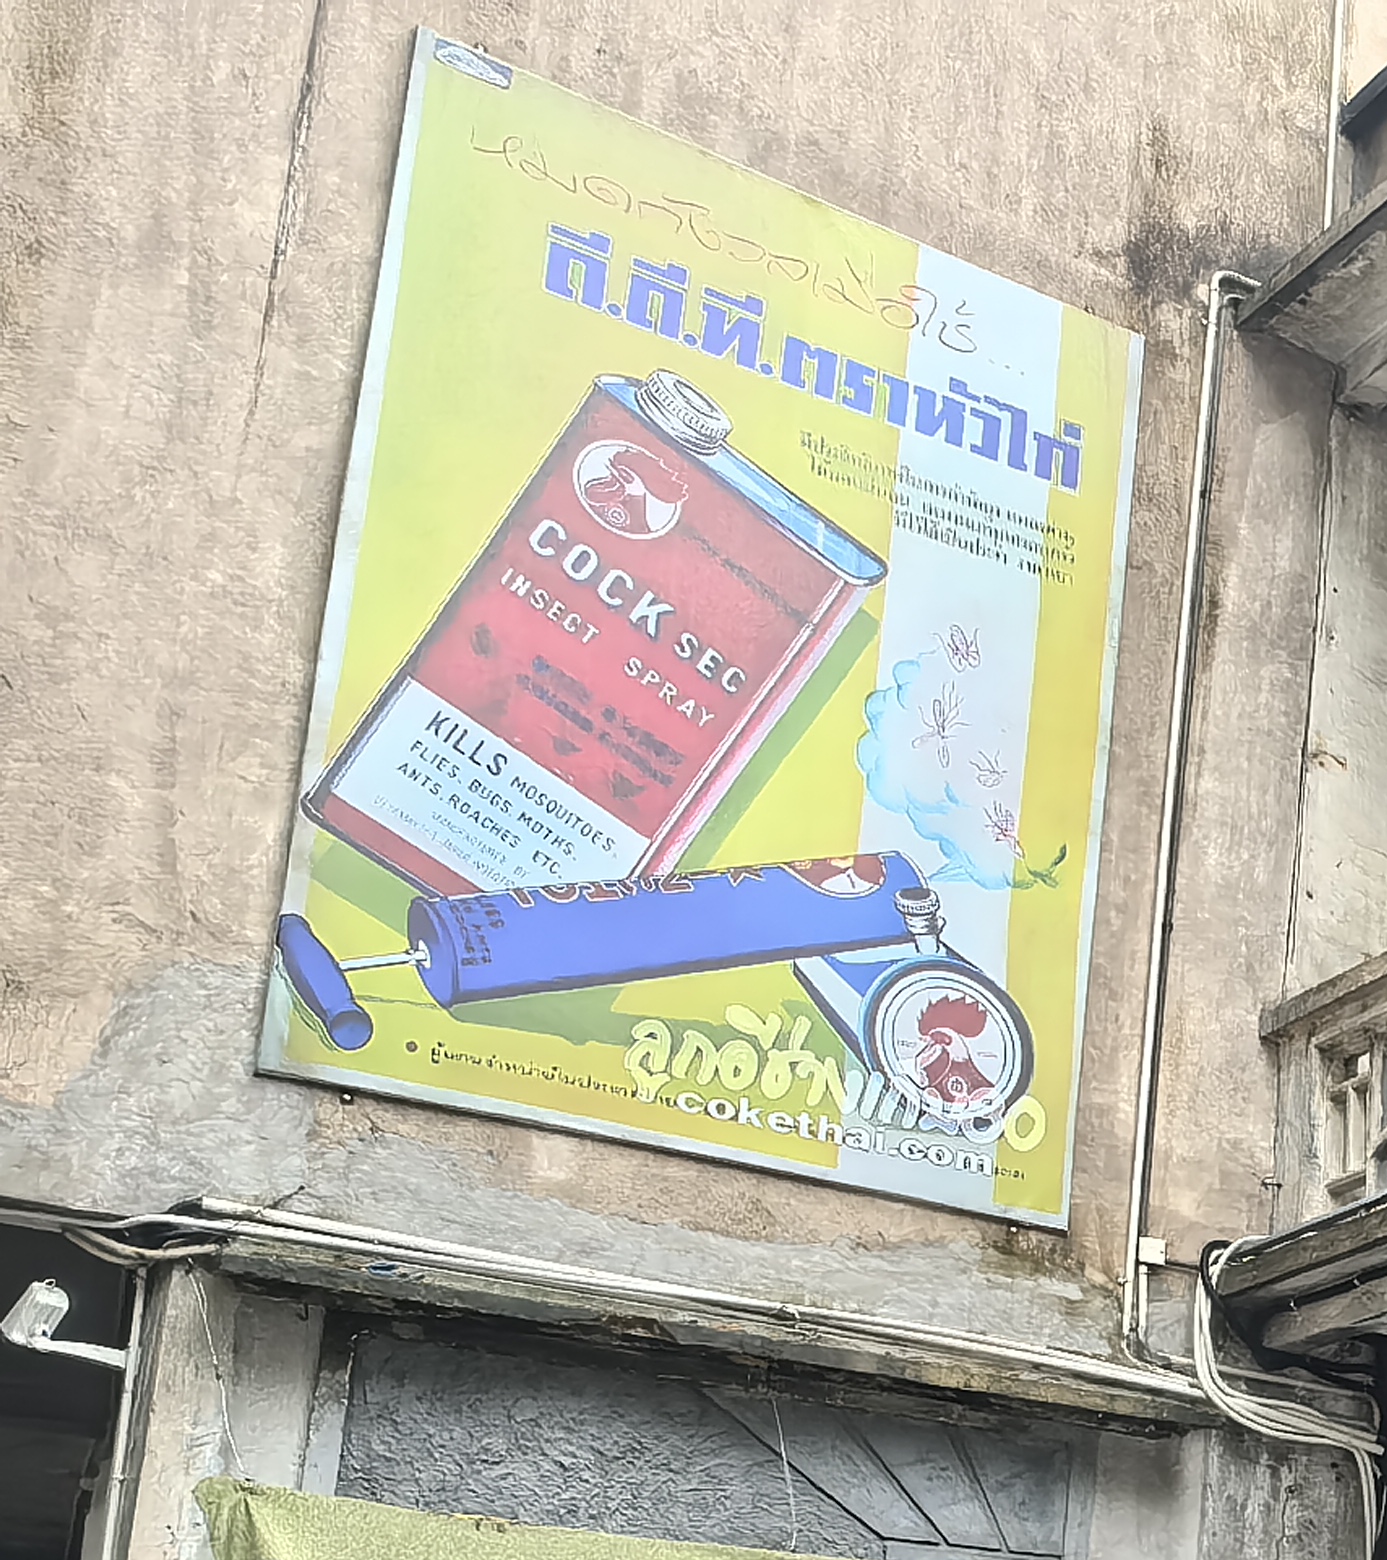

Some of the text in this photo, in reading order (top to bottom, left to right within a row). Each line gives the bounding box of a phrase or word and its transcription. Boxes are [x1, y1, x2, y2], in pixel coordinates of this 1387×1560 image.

[499, 566, 601, 645] INSECT
[622, 655, 716, 728] SPRAY
[528, 517, 676, 640] COCK
[673, 630, 748, 694] SEC
[424, 709, 508, 777] KILLS
